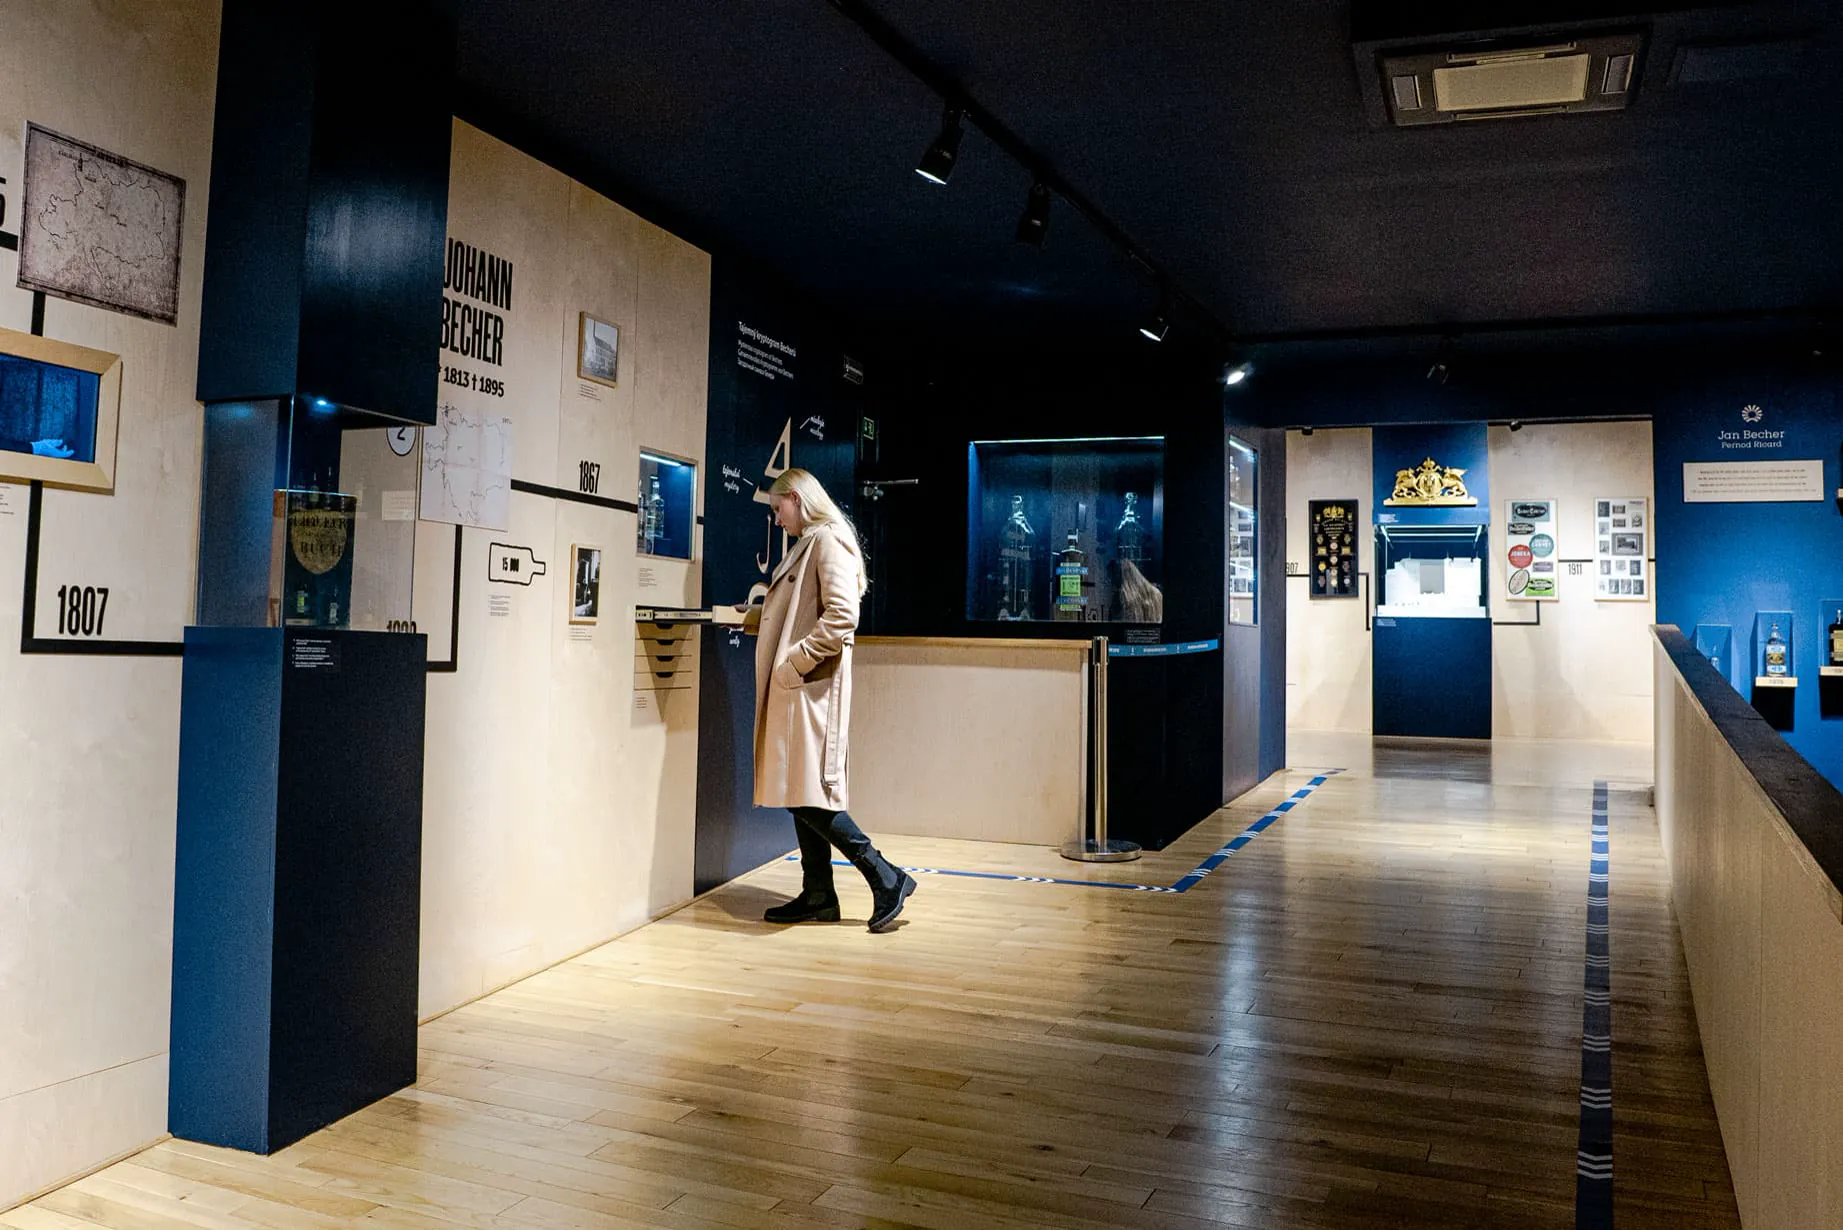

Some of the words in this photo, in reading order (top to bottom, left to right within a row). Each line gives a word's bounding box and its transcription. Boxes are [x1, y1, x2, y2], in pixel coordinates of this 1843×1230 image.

[443, 237, 513, 311] JOHANN
[440, 296, 504, 367] BECHER
[443, 366, 470, 388] 1813
[479, 376, 504, 398] 1895
[1717, 430, 1740, 440] Jan
[1743, 429, 1785, 440] Becher
[1721, 441, 1751, 449] Pernod
[1753, 440, 1782, 448] Ricard
[579, 460, 600, 494] 1867
[502, 556, 509, 571] 15
[1568, 563, 1582, 575] 1911
[58, 584, 109, 636] 1807
